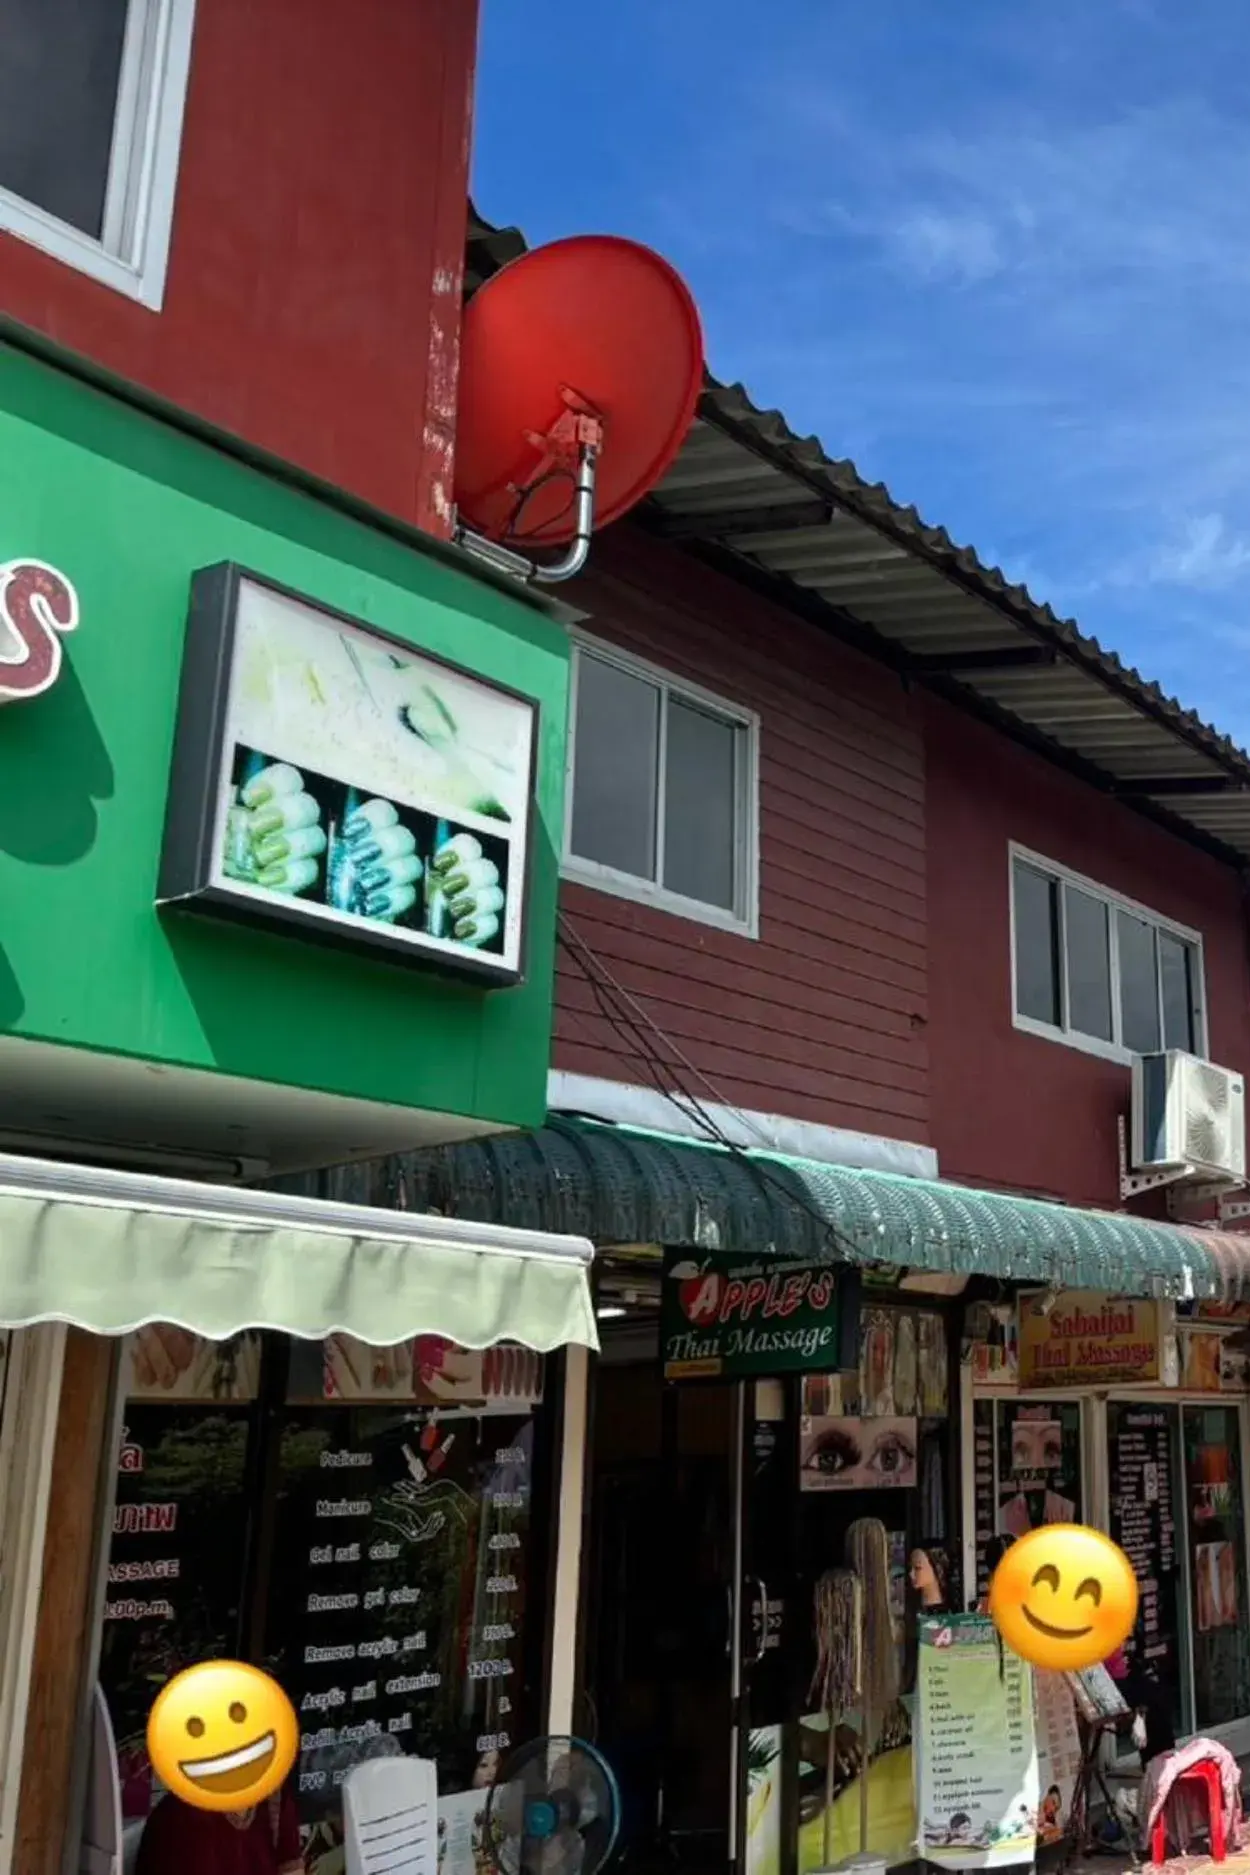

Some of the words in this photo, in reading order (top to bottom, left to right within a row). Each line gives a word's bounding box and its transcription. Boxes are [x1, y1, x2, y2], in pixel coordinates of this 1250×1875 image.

[666, 1327, 722, 1361] Thai
[725, 1325, 835, 1358] Massage
[1074, 1341, 1155, 1369] Massage
[320, 1449, 373, 1467] Pedicure
[315, 1498, 372, 1517] Manicure
[368, 1541, 401, 1560] color
[307, 1593, 358, 1612] Remove
[363, 1586, 385, 1610] gel
[388, 1586, 421, 1607] color
[304, 1645, 356, 1664] Remove
[301, 1686, 346, 1711] Acrylic
[385, 1671, 441, 1695] extension
